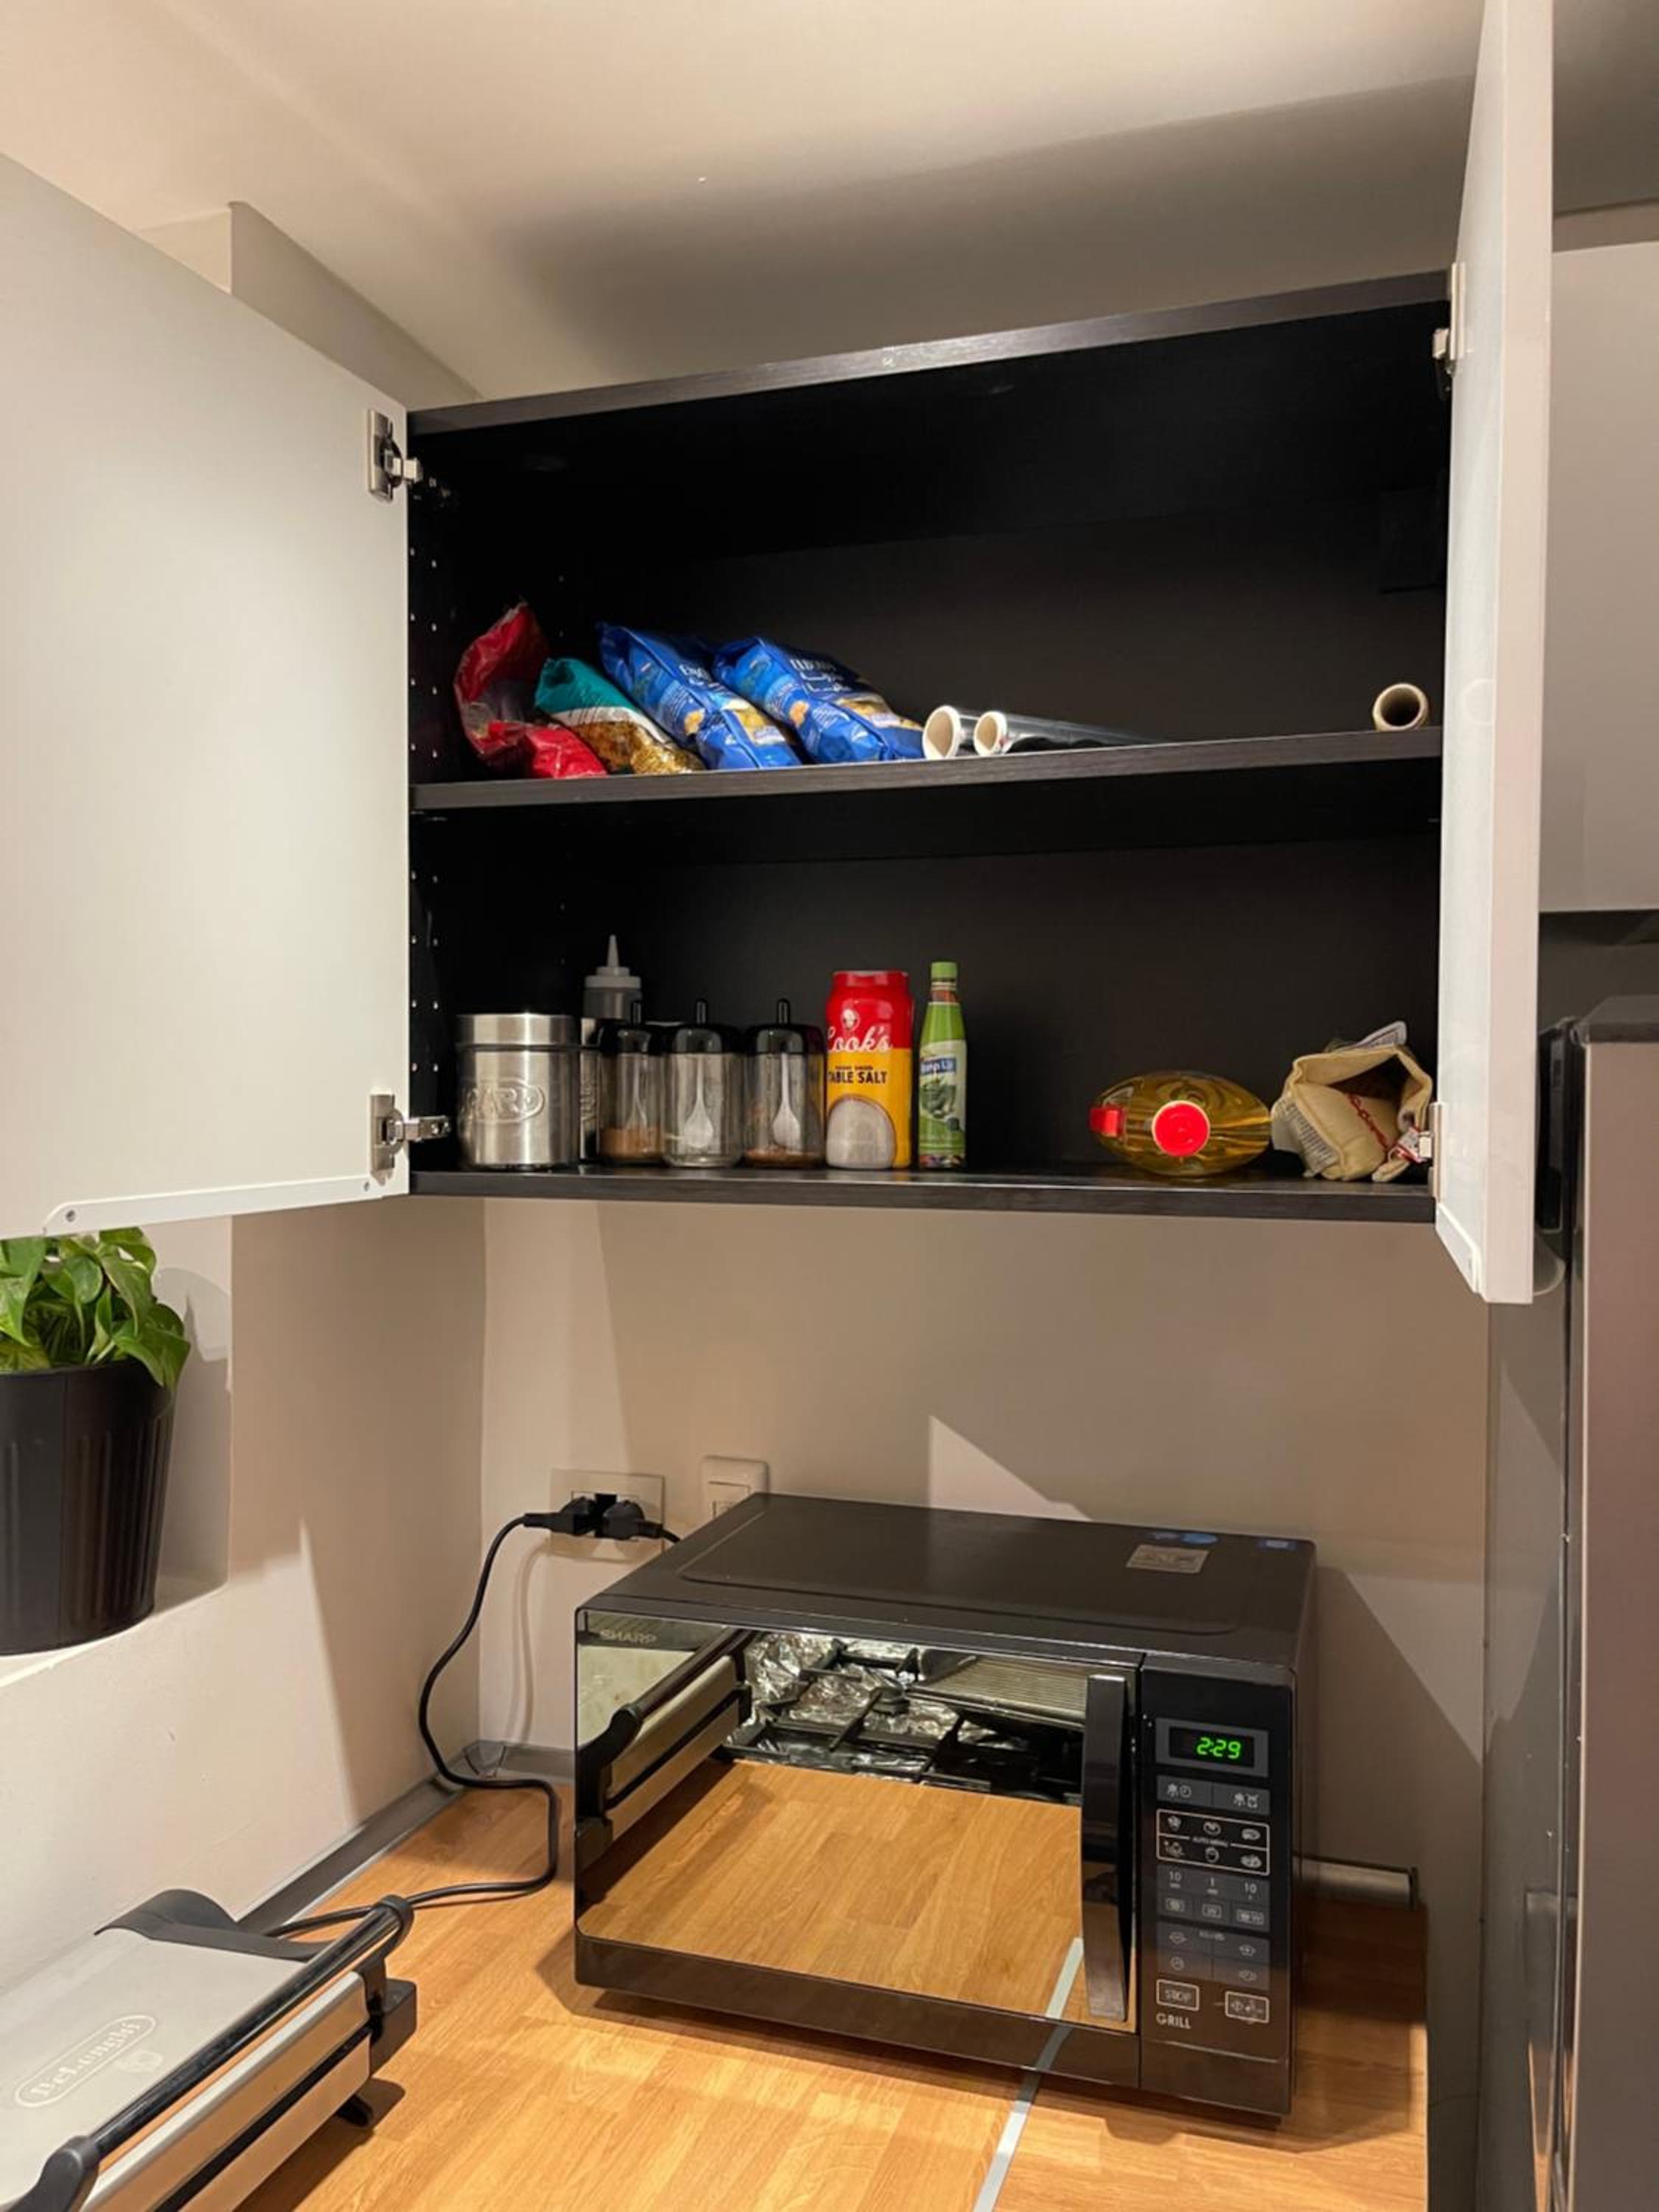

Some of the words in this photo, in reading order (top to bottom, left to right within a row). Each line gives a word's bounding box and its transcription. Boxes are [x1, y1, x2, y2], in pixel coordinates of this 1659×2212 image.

[858, 1071, 888, 1084] SALT
[599, 1628, 658, 1645] SHARP
[1196, 1736, 1242, 1760] 2:29
[1169, 1871, 1182, 1882] 10
[1244, 1881, 1257, 1894] 10
[1155, 2012, 1192, 2030] GRILL
